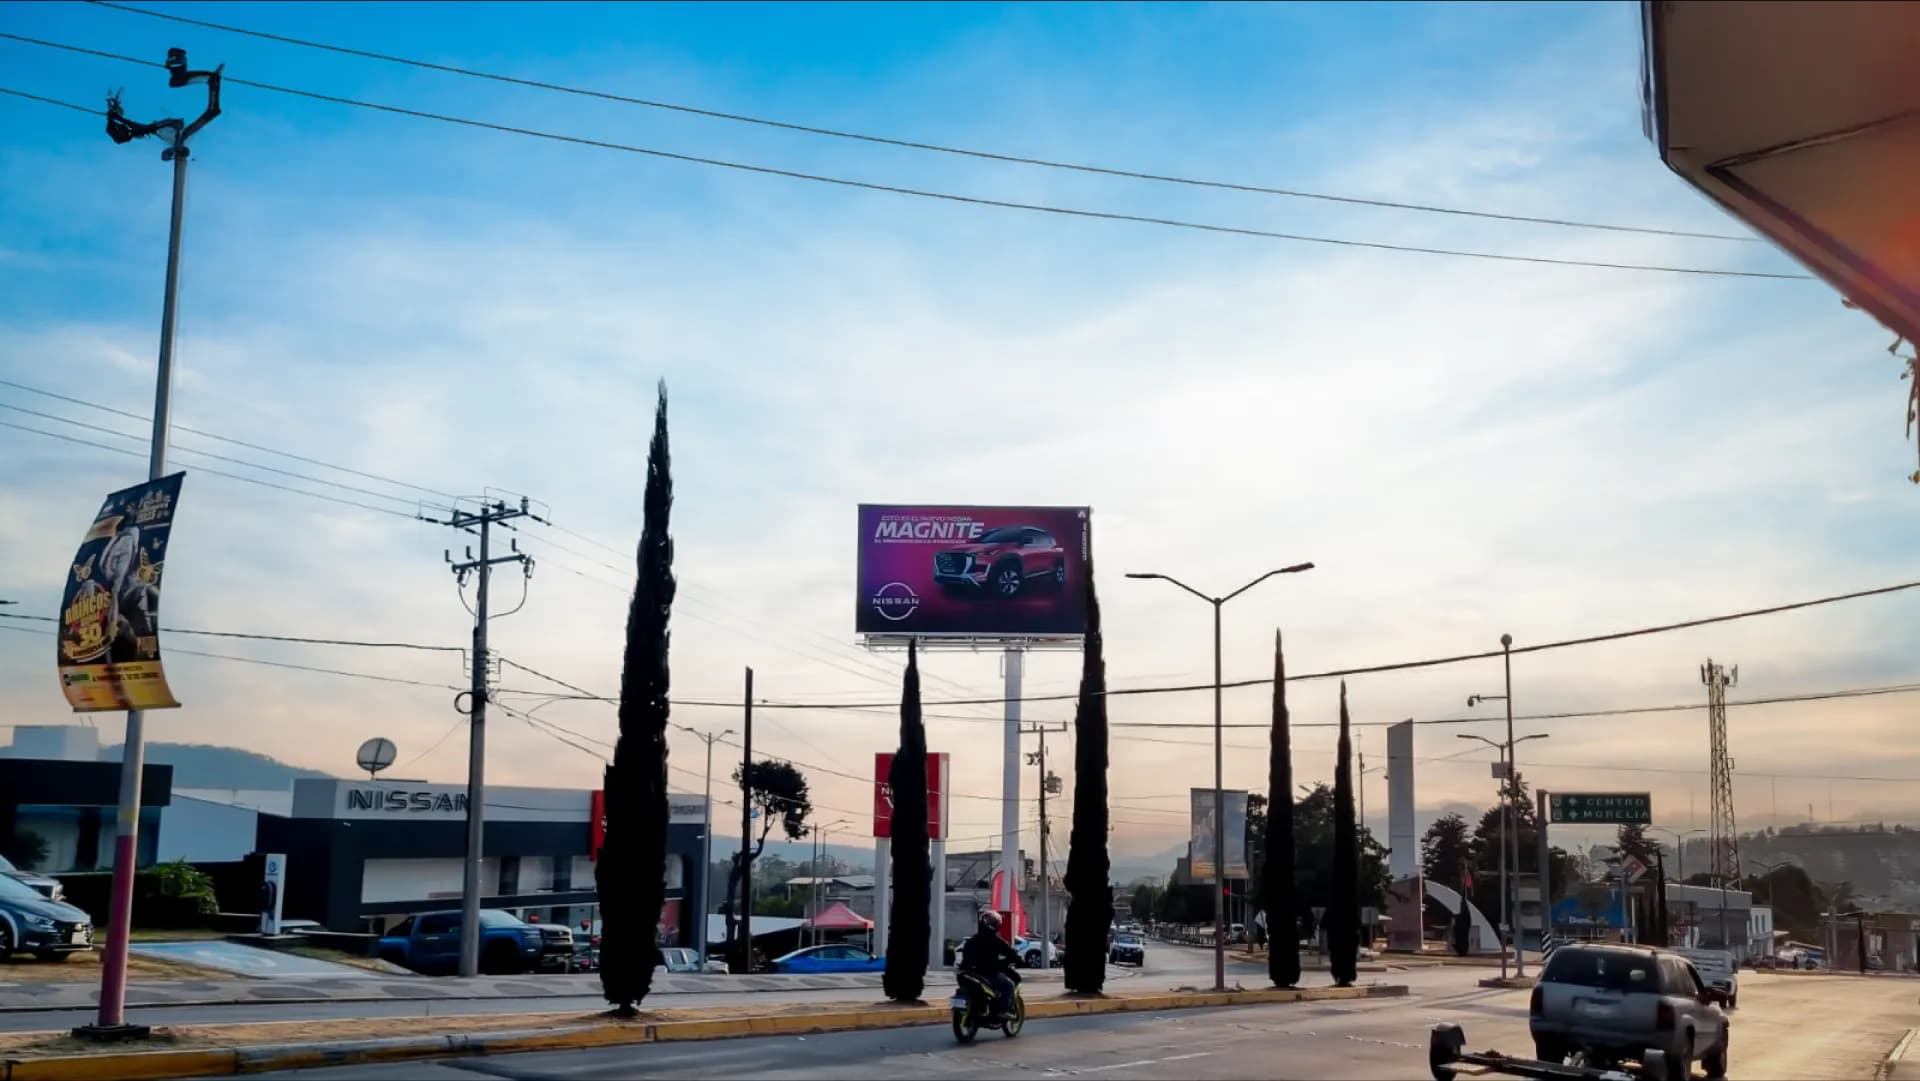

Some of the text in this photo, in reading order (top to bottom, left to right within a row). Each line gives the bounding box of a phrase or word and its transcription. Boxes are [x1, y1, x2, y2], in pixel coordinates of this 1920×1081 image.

[874, 522, 985, 538] MAGNITE
[872, 597, 920, 605] NISSAN
[1586, 798, 1645, 806] CENTRO
[1583, 810, 1649, 819] MORELIA
